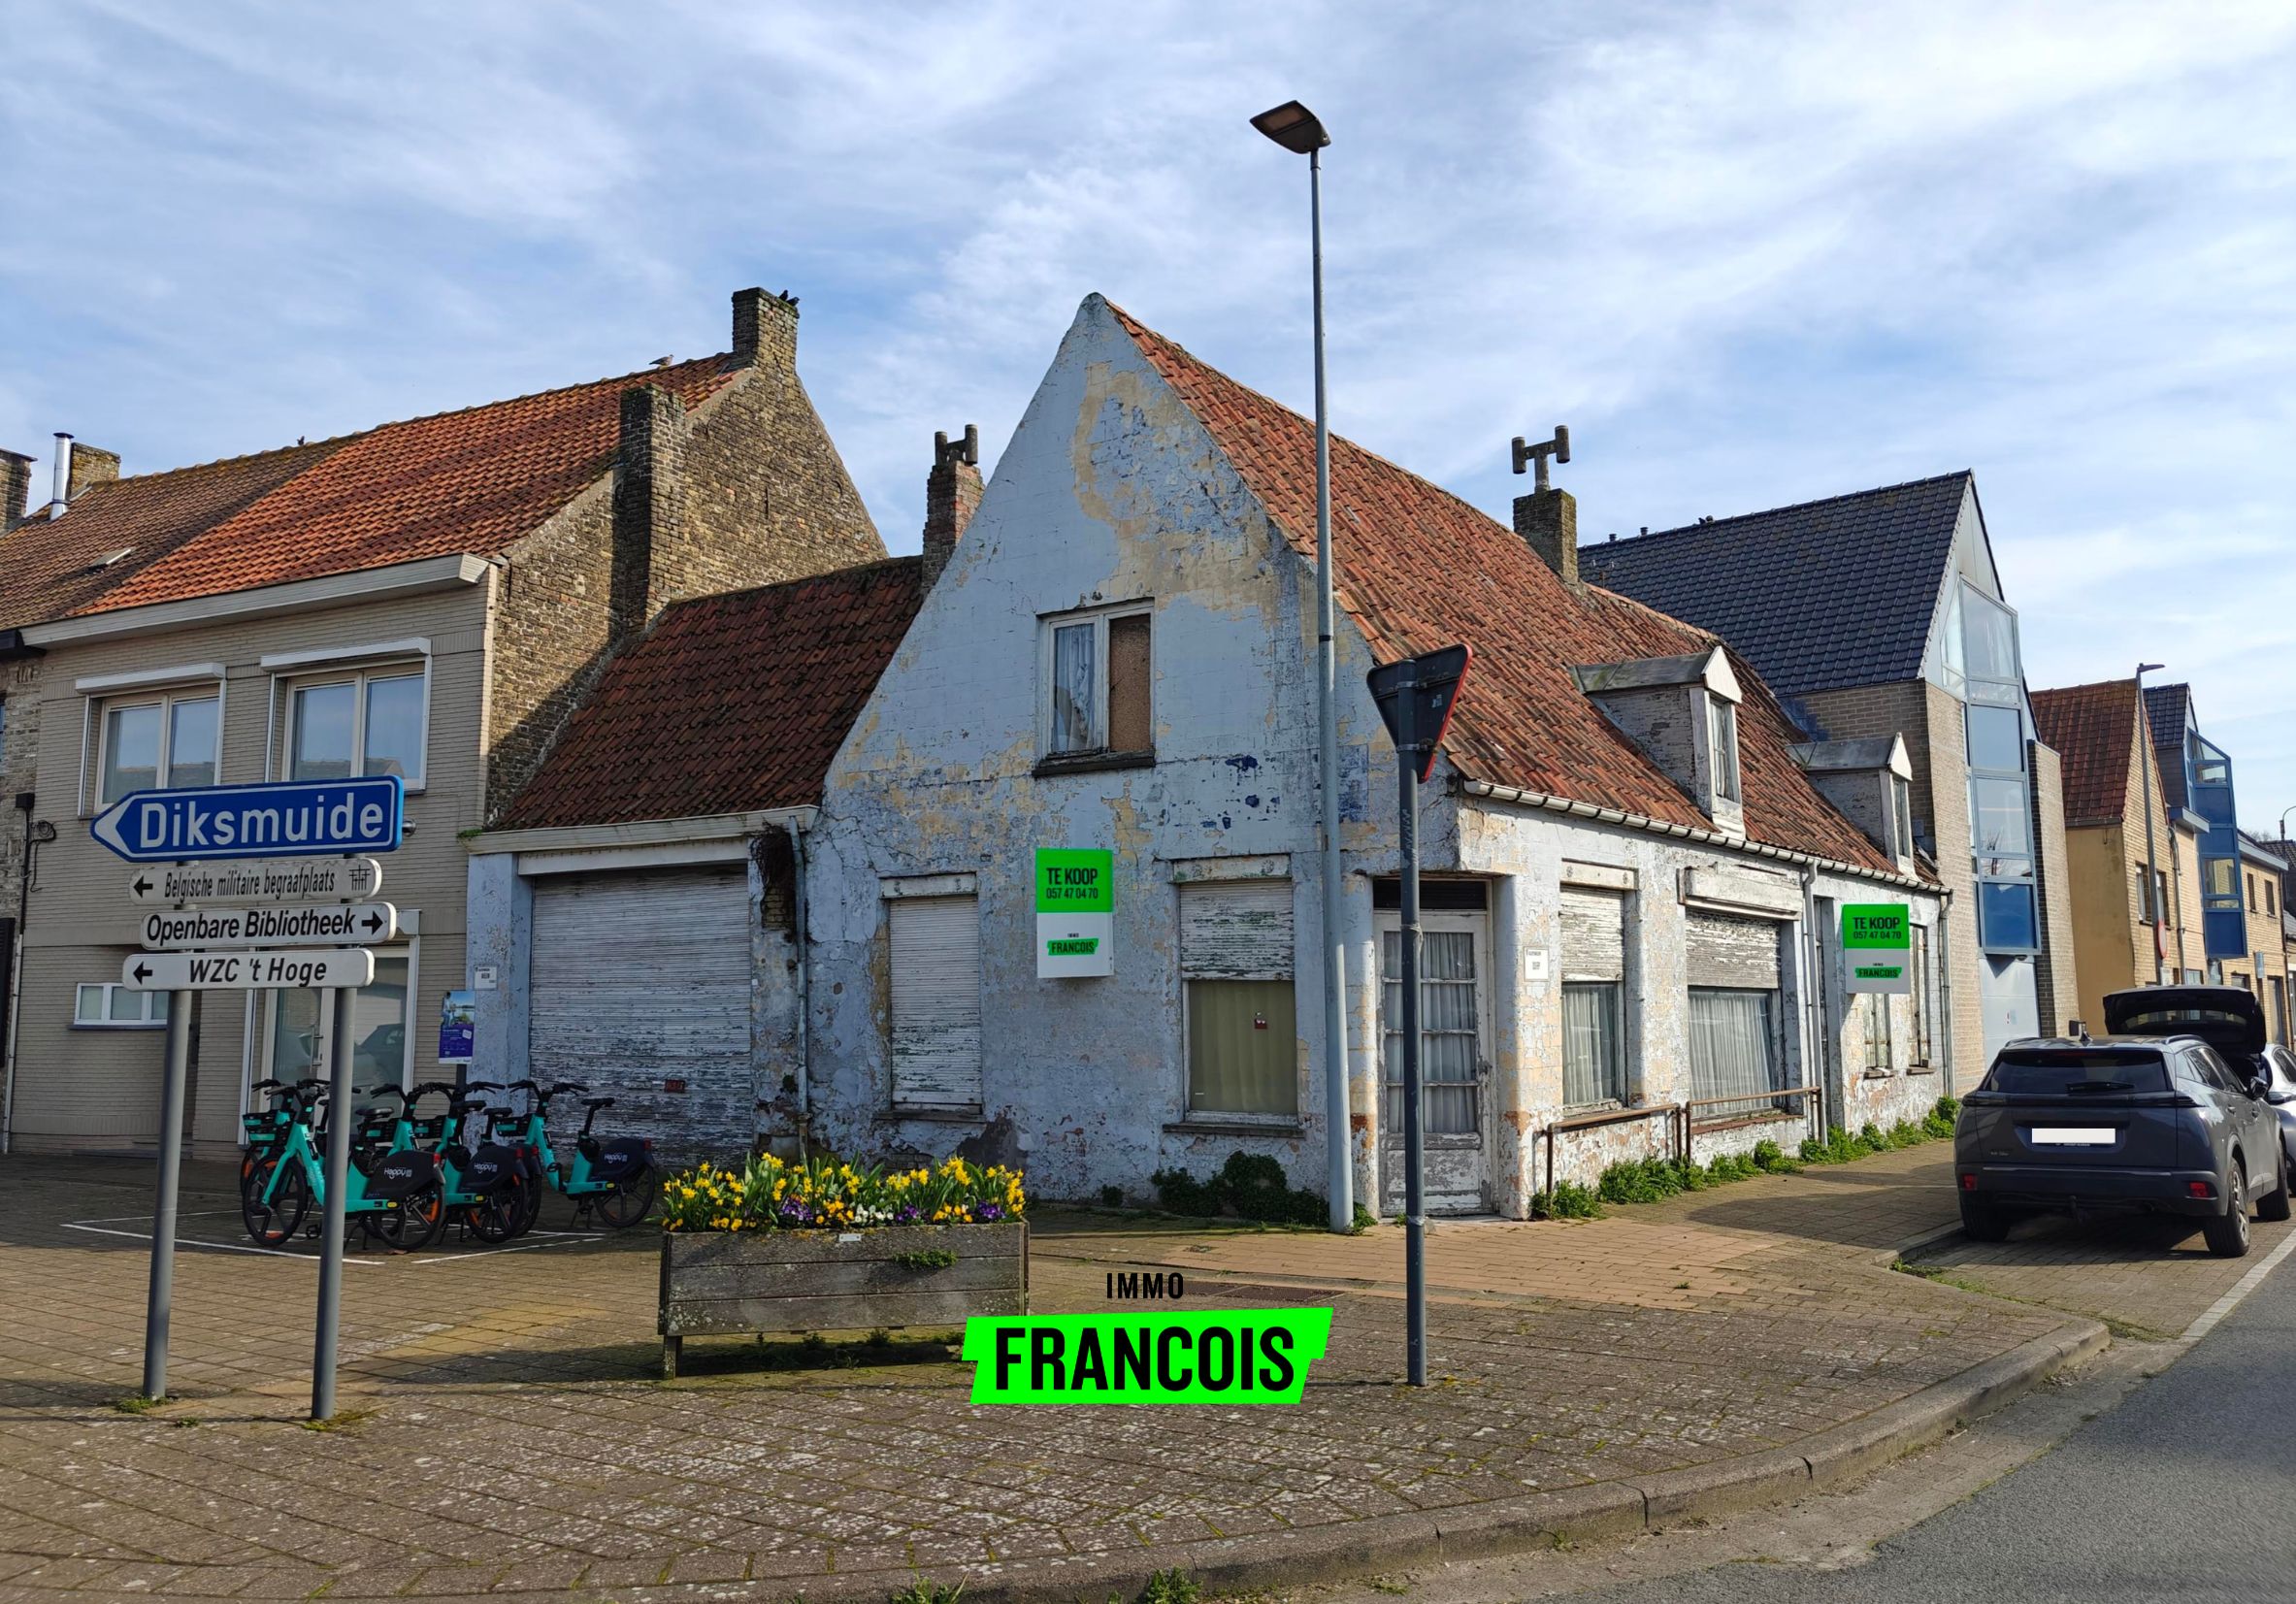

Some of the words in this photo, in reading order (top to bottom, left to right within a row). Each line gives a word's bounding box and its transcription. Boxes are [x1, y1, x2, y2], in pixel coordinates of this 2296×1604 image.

[140, 792, 384, 849] Diksmuide
[164, 871, 213, 903] Belgische
[216, 869, 260, 897] militaire
[263, 867, 336, 900] begraafplaats
[1046, 867, 1062, 885] TE
[1065, 867, 1099, 885] KOOP
[1046, 887, 1062, 900] 057
[1064, 887, 1073, 900] 47
[1075, 887, 1086, 900] 04
[1089, 887, 1099, 900] 70
[147, 912, 240, 946] Openbare
[244, 907, 355, 939] Bibliotheek
[1853, 917, 1866, 930] TE
[1869, 917, 1900, 930] KOOP
[1051, 941, 1095, 954] FRANCOIS
[187, 958, 241, 984] WZC
[248, 959, 261, 982] 't
[267, 957, 328, 988] Hoge
[1858, 968, 1899, 978] FRANCOIS
